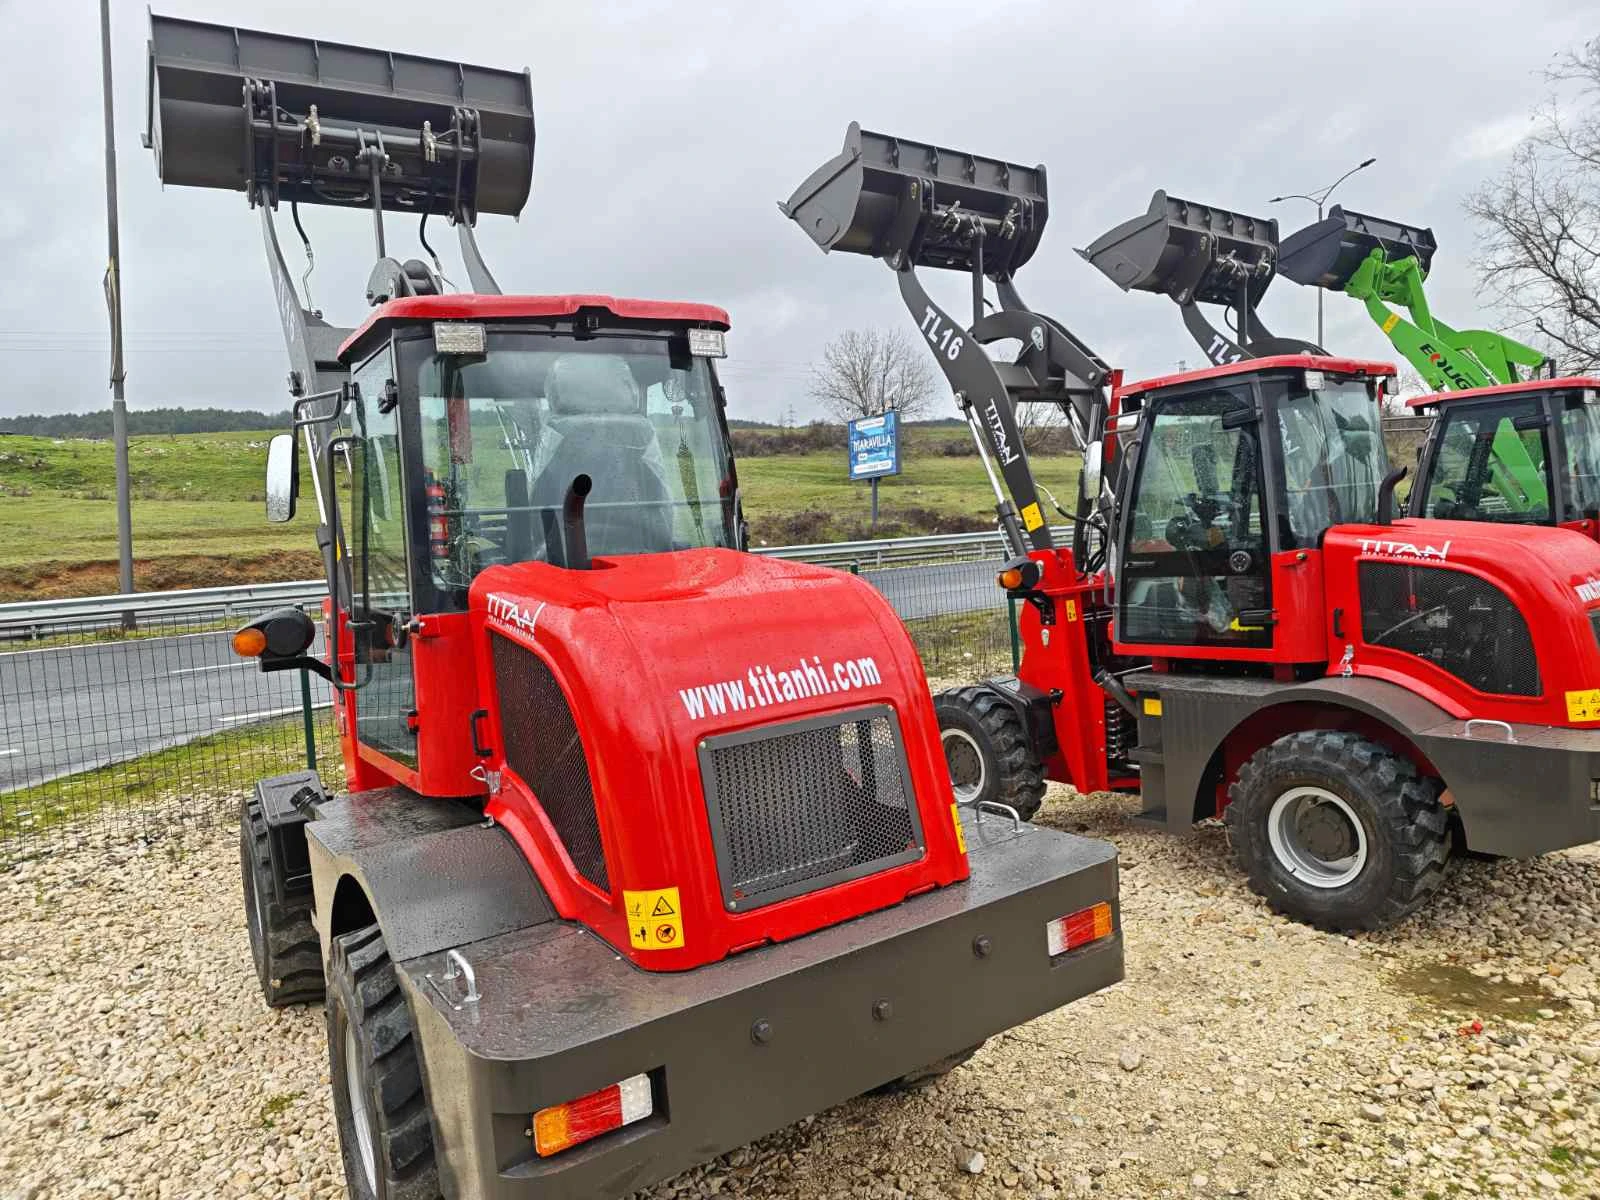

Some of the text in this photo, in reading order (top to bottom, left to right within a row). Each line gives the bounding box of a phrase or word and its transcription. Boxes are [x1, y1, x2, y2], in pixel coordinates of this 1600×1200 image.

[920, 305, 964, 361] TL16
[853, 433, 892, 452] MARAVILLA
[986, 397, 1020, 465] TITAN
[1356, 538, 1452, 560] TITAN
[486, 592, 546, 634] TITAN
[679, 655, 882, 720] www.titanhi.com
